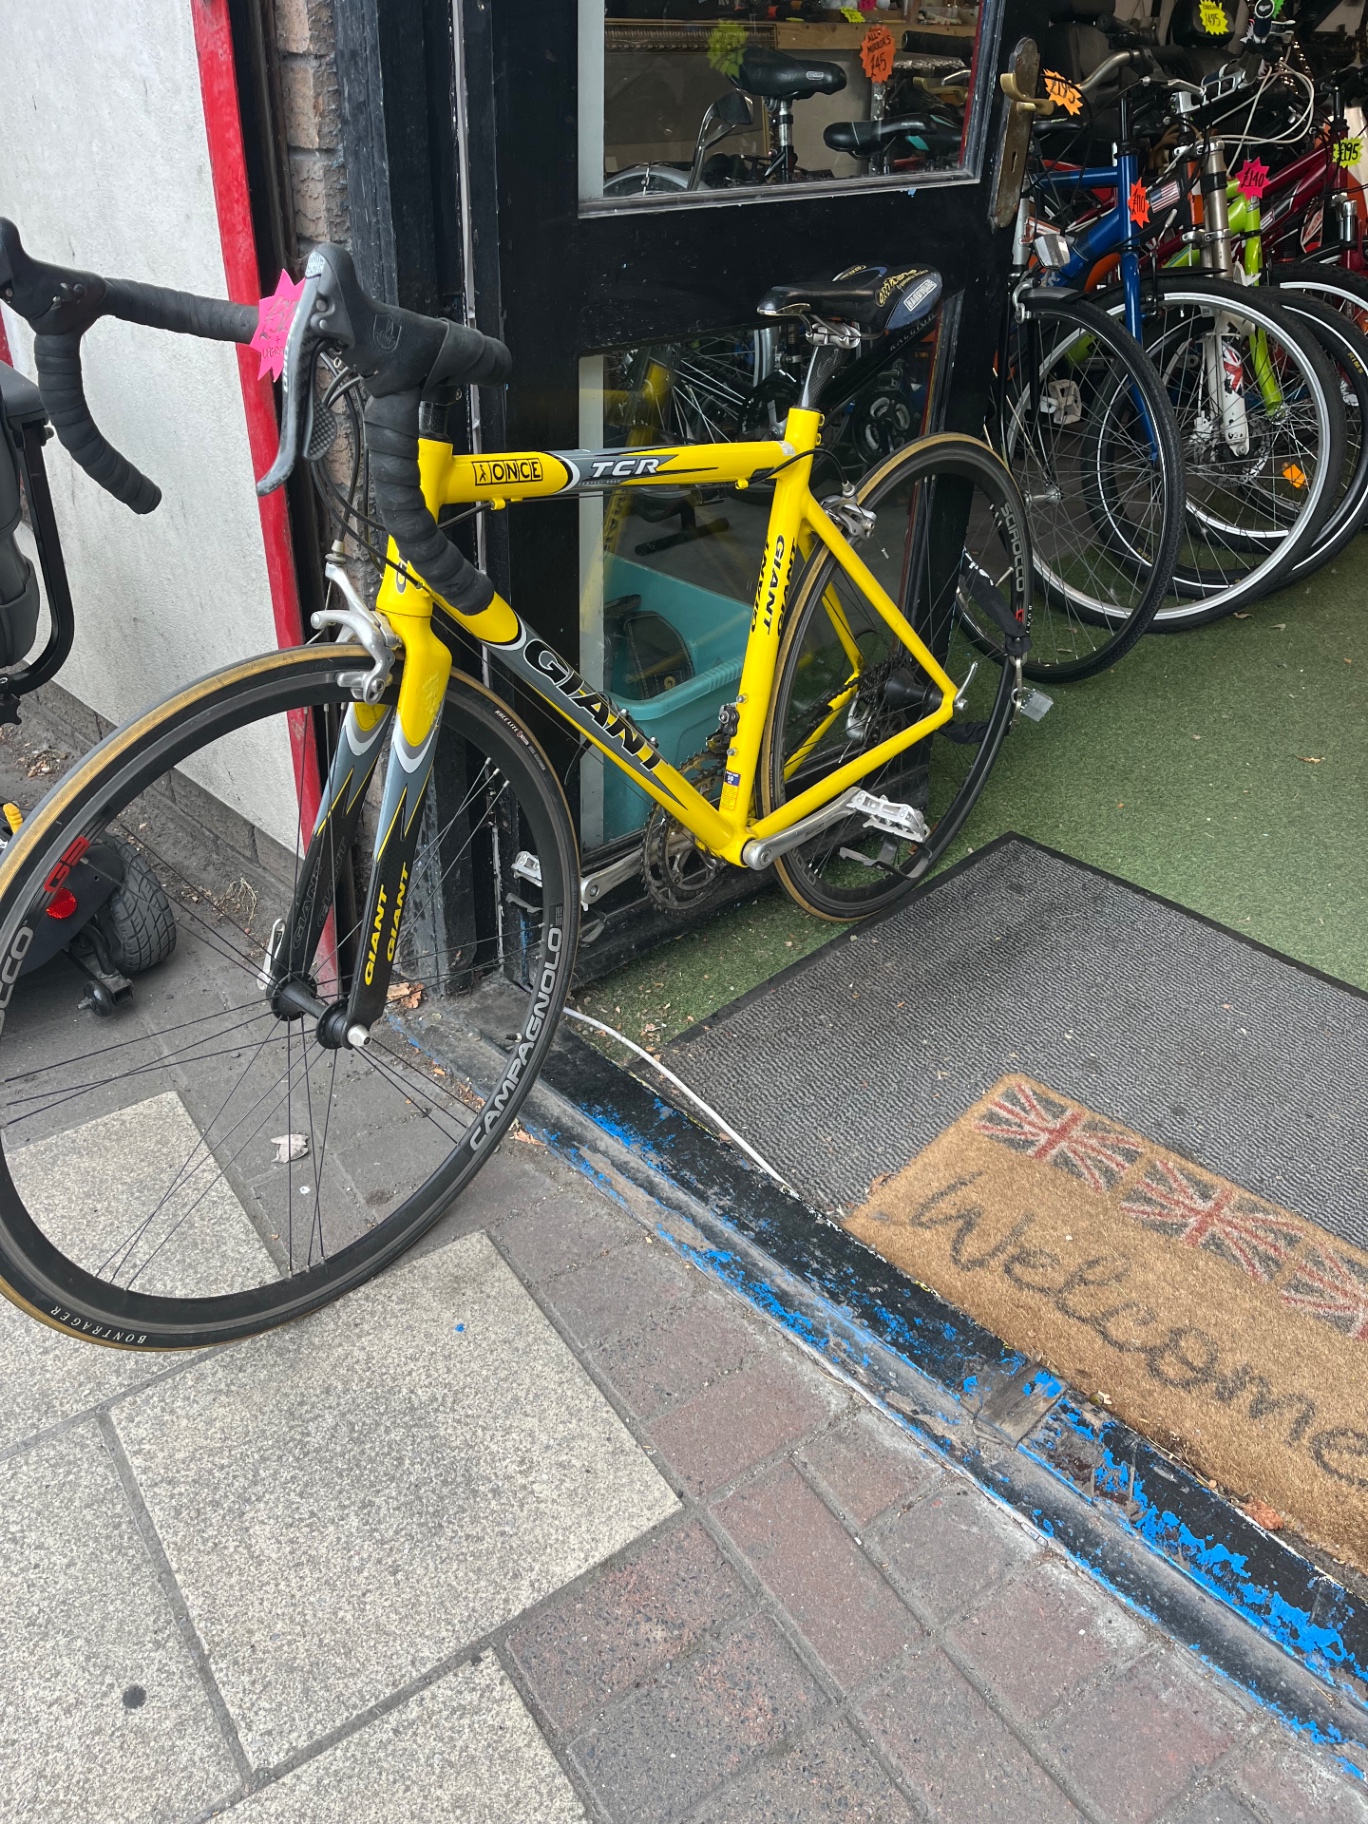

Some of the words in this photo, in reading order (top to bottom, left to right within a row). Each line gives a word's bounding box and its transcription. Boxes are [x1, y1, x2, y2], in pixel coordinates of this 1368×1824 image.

[1240, 166, 1264, 188] £140
[491, 460, 541, 481] ONCE
[591, 459, 660, 478] TCR
[763, 534, 785, 636] GIANT
[1000, 502, 1025, 593] SCIROCCO
[523, 638, 669, 772] GIANT
[364, 884, 388, 986] GIANT
[387, 861, 409, 962] GIANT
[0, 926, 34, 1034] CCO
[469, 927, 563, 1151] CAMPAGNOLO
[50, 1305, 148, 1344] BONTRAGER
[911, 1170, 1368, 1487] Welcome
